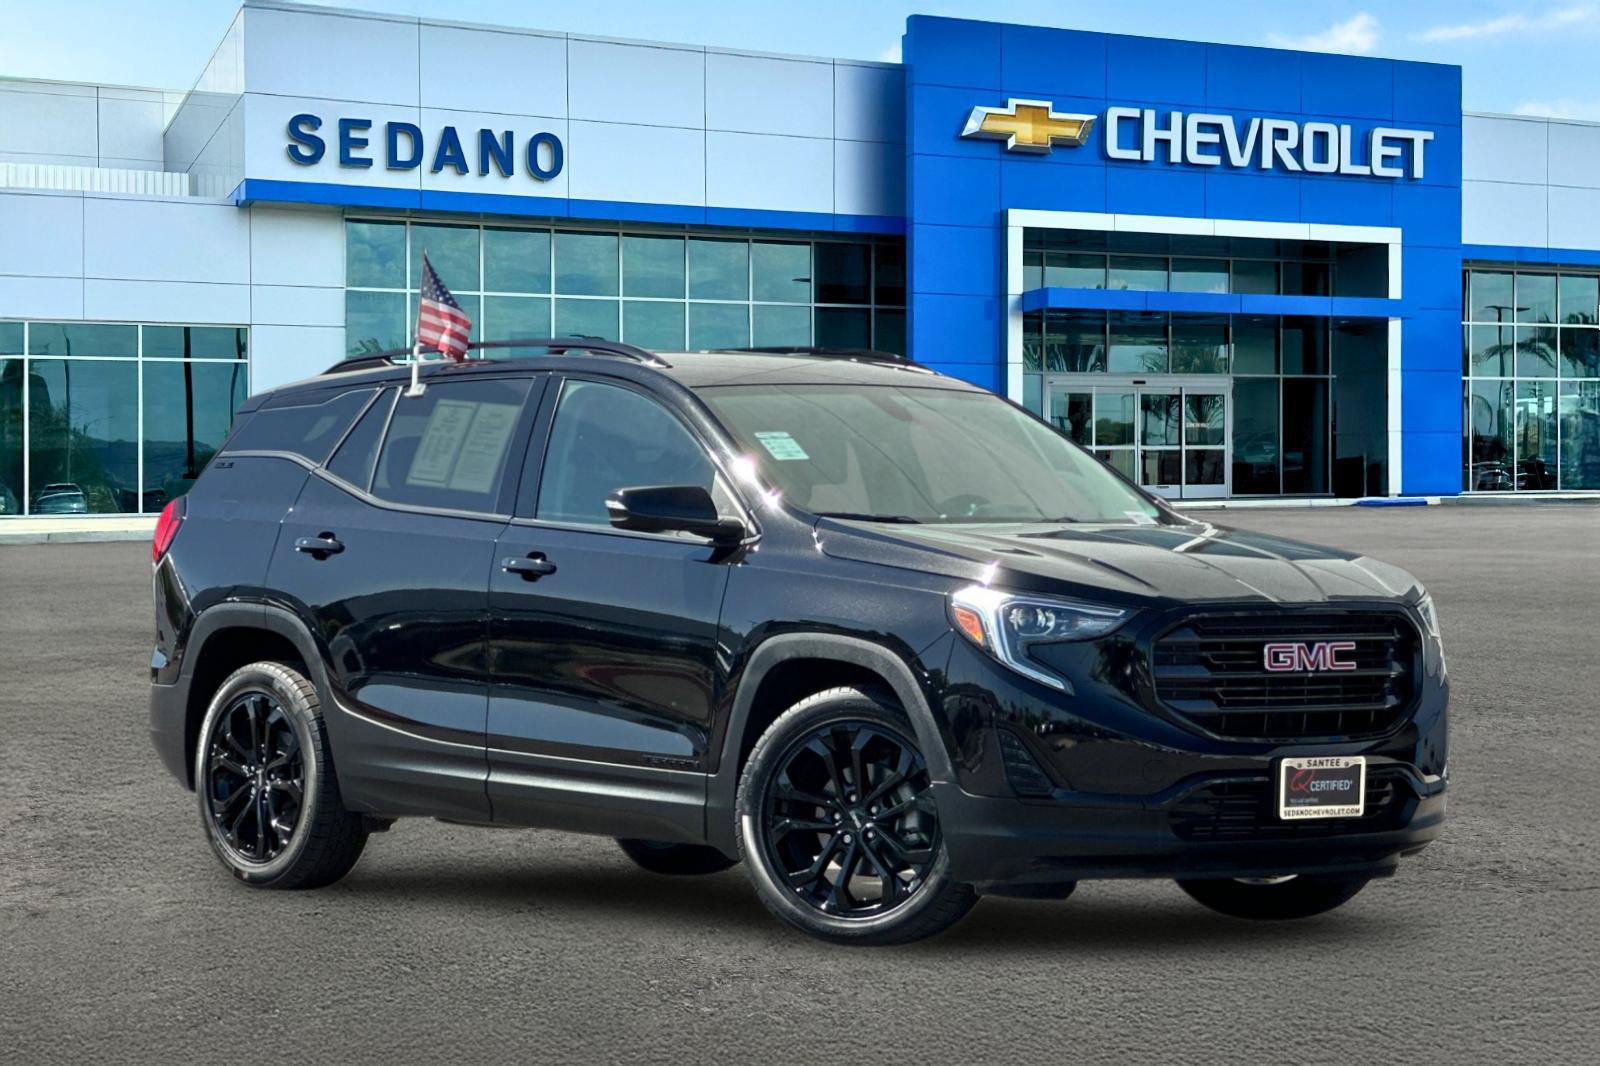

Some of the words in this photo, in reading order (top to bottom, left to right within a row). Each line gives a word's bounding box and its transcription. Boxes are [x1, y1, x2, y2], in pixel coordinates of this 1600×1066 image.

[286, 113, 565, 183] SEDANO
[1105, 105, 1435, 180] CHEVROLET
[1263, 641, 1357, 671] GMC
[1306, 758, 1341, 768] SANTEE
[1309, 779, 1351, 792] CERTIFIED
[1283, 807, 1361, 818] SEDANOCHEVROLET.COM
